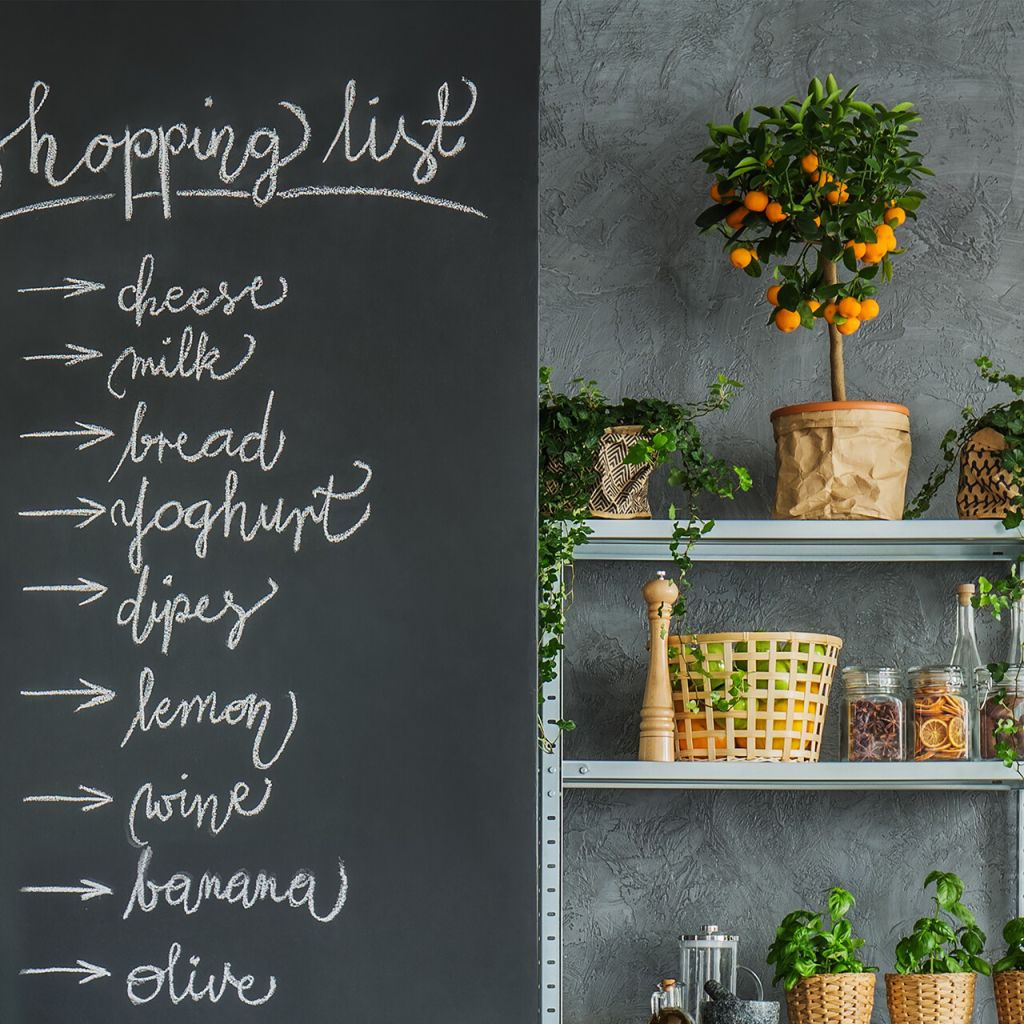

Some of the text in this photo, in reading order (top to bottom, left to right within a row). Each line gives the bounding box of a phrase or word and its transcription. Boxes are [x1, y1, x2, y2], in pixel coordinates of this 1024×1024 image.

[322, 77, 477, 185] list
[117, 253, 289, 327] cheese
[107, 325, 257, 399] milk
[108, 389, 287, 483] bread
[121, 666, 299, 770] lemon
[127, 772, 273, 847] wine
[122, 845, 348, 923] banana
[126, 941, 277, 1006] olive
